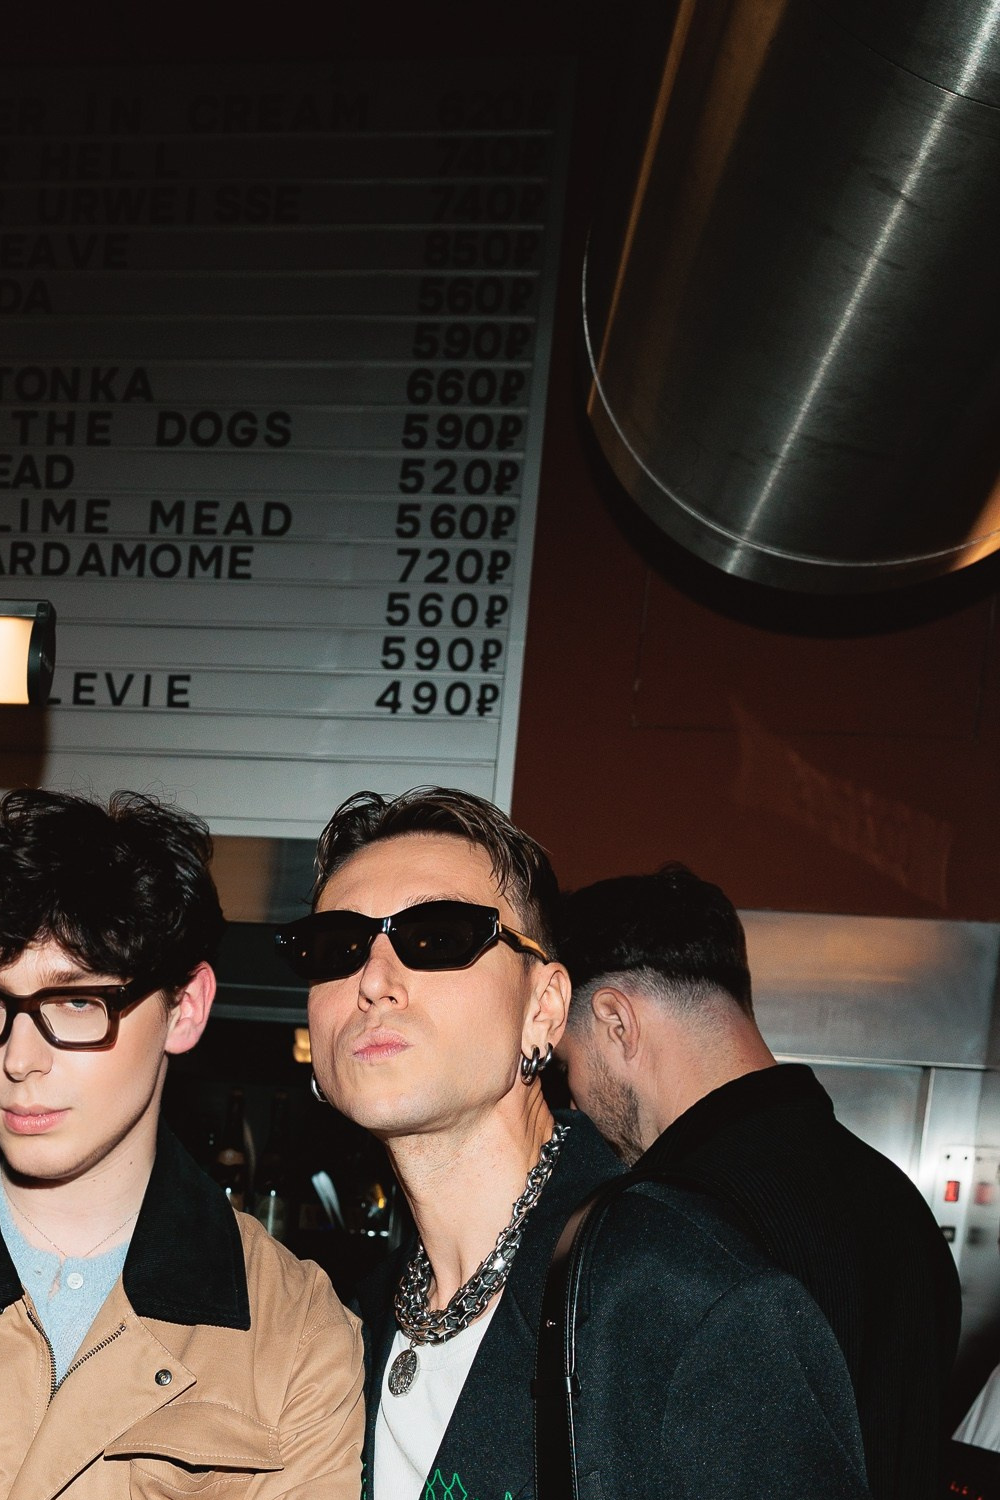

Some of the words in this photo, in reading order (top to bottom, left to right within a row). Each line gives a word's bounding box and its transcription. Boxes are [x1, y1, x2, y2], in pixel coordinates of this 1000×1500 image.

[85, 93, 142, 133] IN
[187, 93, 370, 133] CREAM
[39, 142, 180, 180] HELL
[36, 186, 301, 225] URWEISSE
[11, 410, 114, 448] THE
[155, 410, 293, 449] DOGS
[149, 500, 293, 538] MEAD
